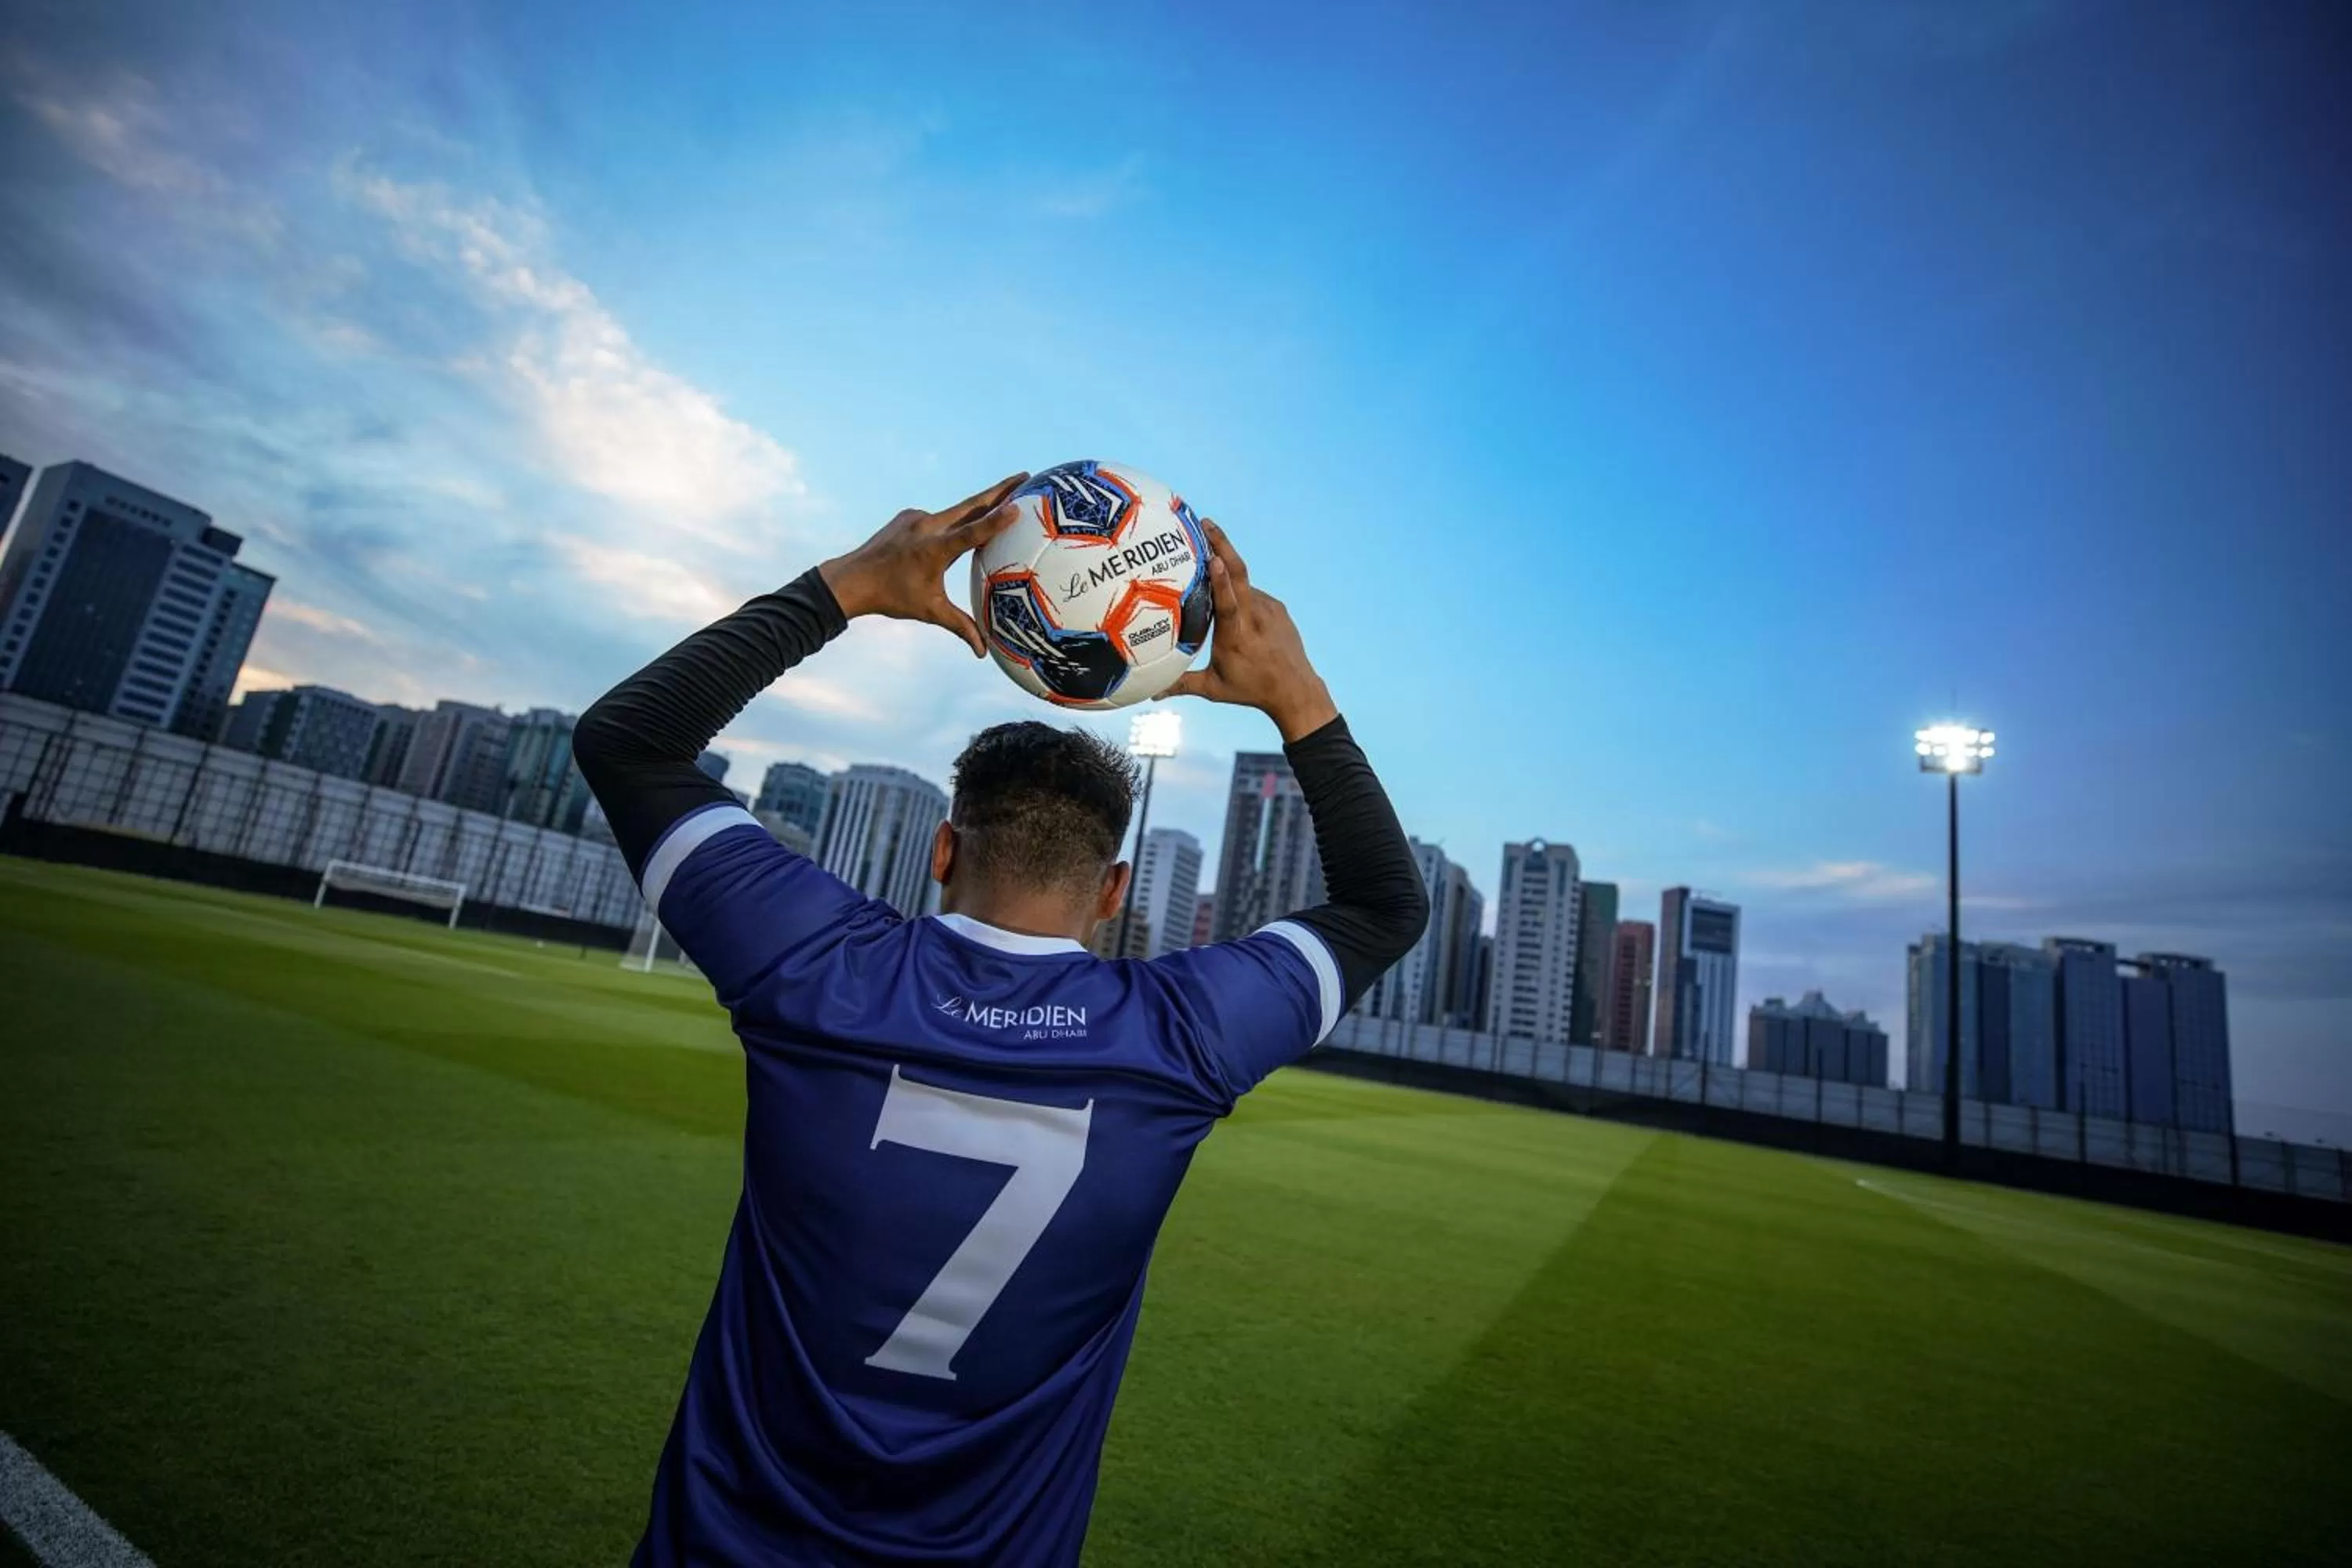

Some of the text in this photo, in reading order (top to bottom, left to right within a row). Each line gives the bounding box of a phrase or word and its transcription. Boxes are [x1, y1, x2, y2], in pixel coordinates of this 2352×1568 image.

[1060, 529, 1185, 602] Le MERIDIEN
[1152, 562, 1169, 575] ABU
[932, 995, 1086, 1029] Le MERIDIEN
[1023, 1029, 1048, 1040] ABU
[864, 1064, 1094, 1381] 7
